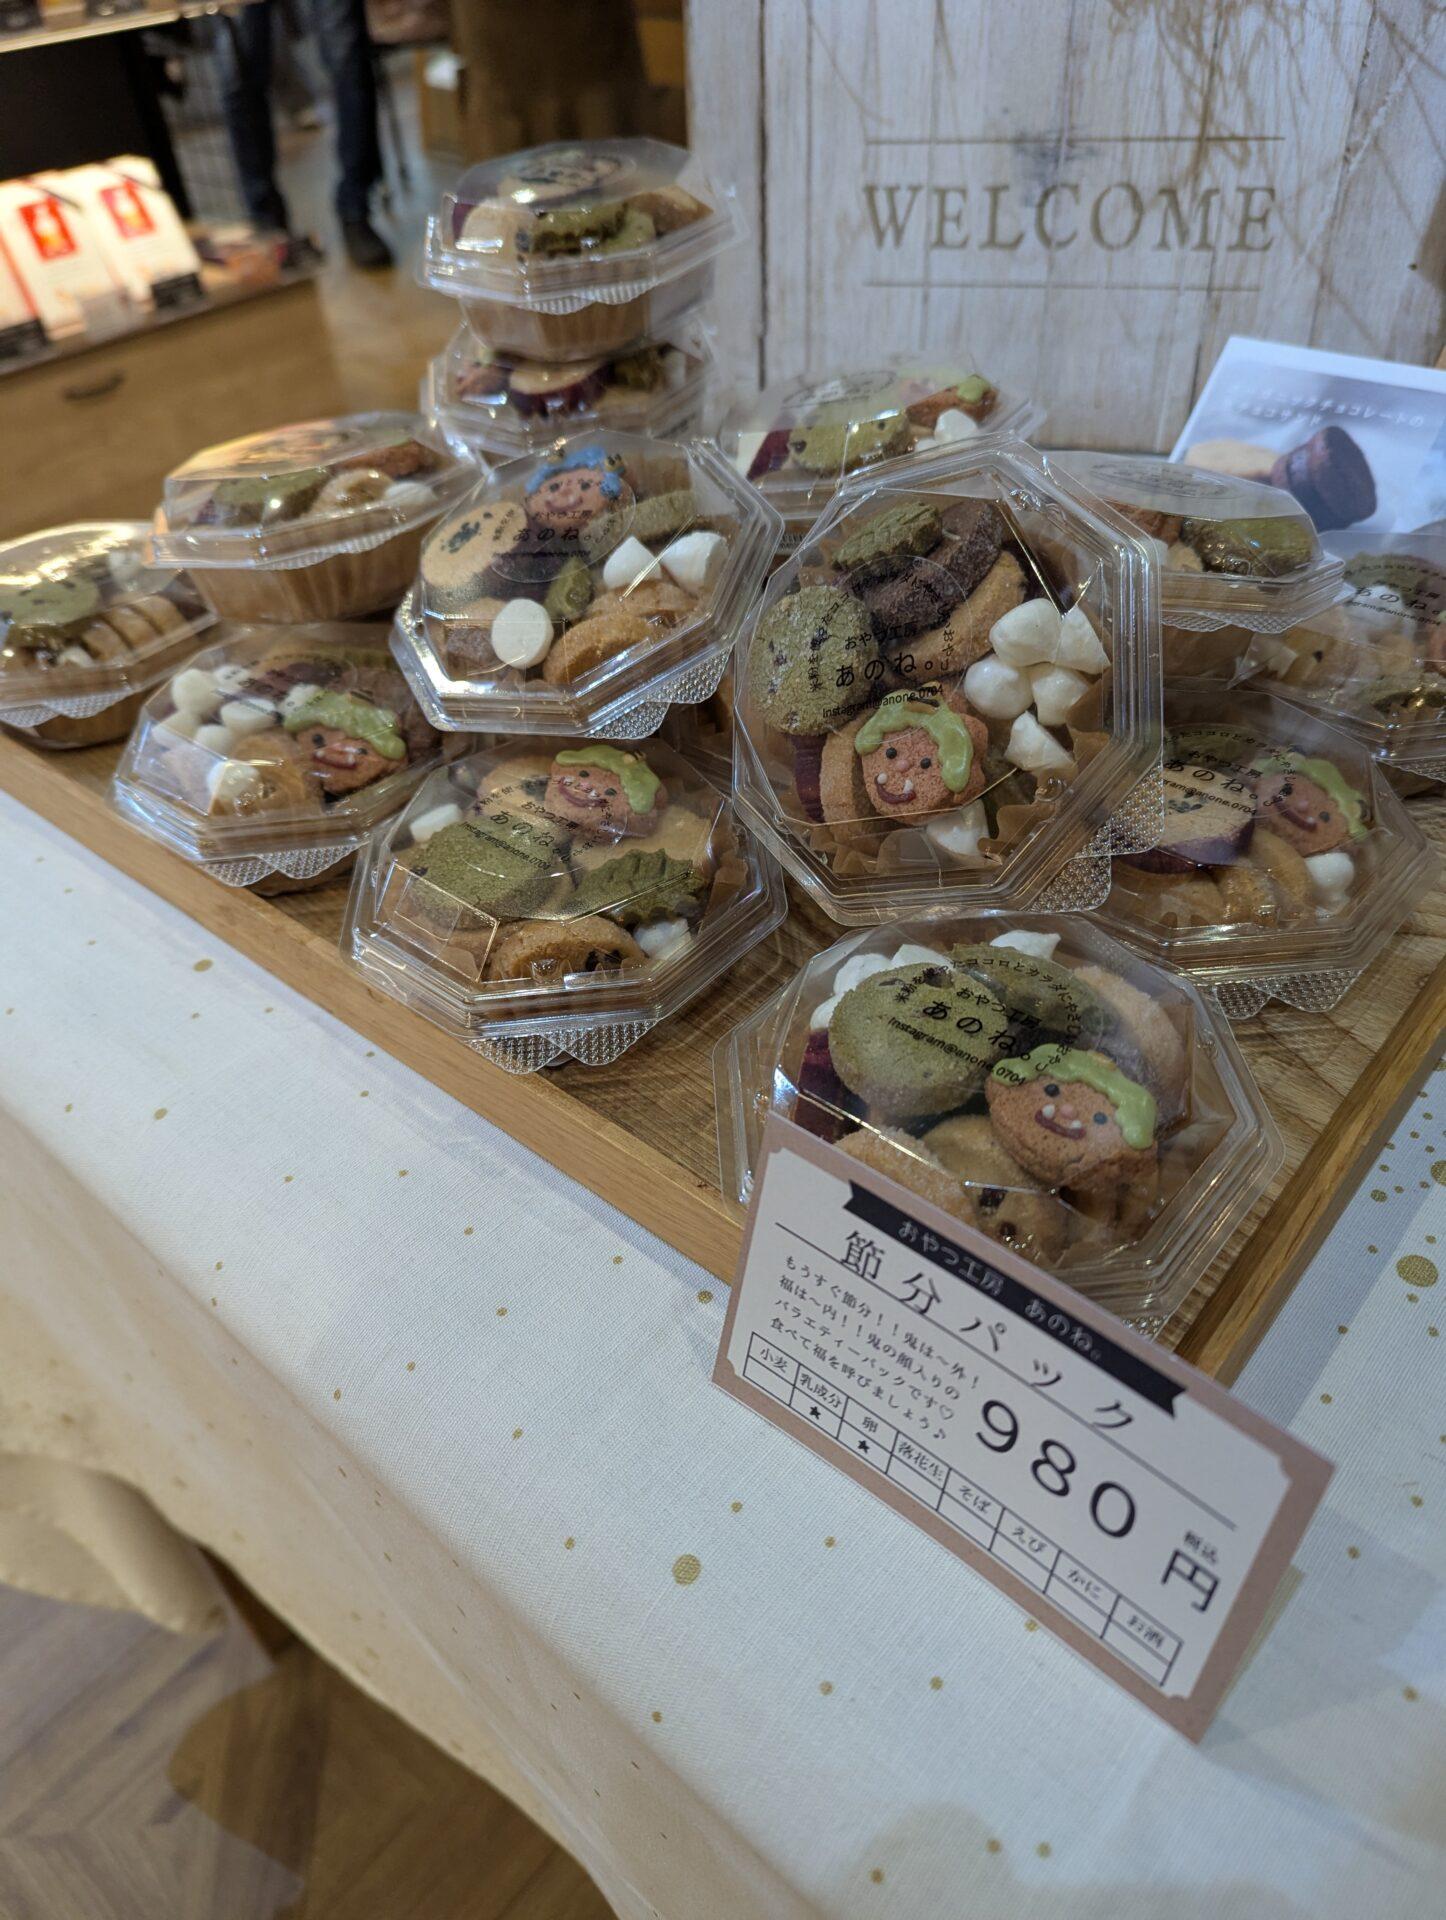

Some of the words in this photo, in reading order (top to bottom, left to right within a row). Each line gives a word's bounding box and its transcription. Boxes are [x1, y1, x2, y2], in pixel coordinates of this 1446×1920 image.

[863, 182, 1277, 252] WELCOME
[513, 527, 591, 541] あのね。
[836, 652, 933, 687] あのね。
[1163, 760, 1258, 800] あのね。
[490, 810, 561, 855] あのね。
[923, 1000, 1030, 1061] あのね。
[957, 987, 1042, 1029] おやつ工房
[899, 1220, 1006, 1296] おやつ工房
[1025, 1299, 1101, 1361] あのね。
[841, 1230, 1133, 1429] 節分パック
[760, 1348, 787, 1374] 小麦
[800, 1373, 842, 1409] 乳成分
[862, 1416, 878, 1433] 卵
[899, 1441, 944, 1481] 落花生
[959, 1484, 991, 1514] そば
[1012, 1526, 1048, 1554] えび
[1067, 1569, 1102, 1599] かに
[976, 1399, 1136, 1538] 980
[1161, 1549, 1219, 1613] 円
